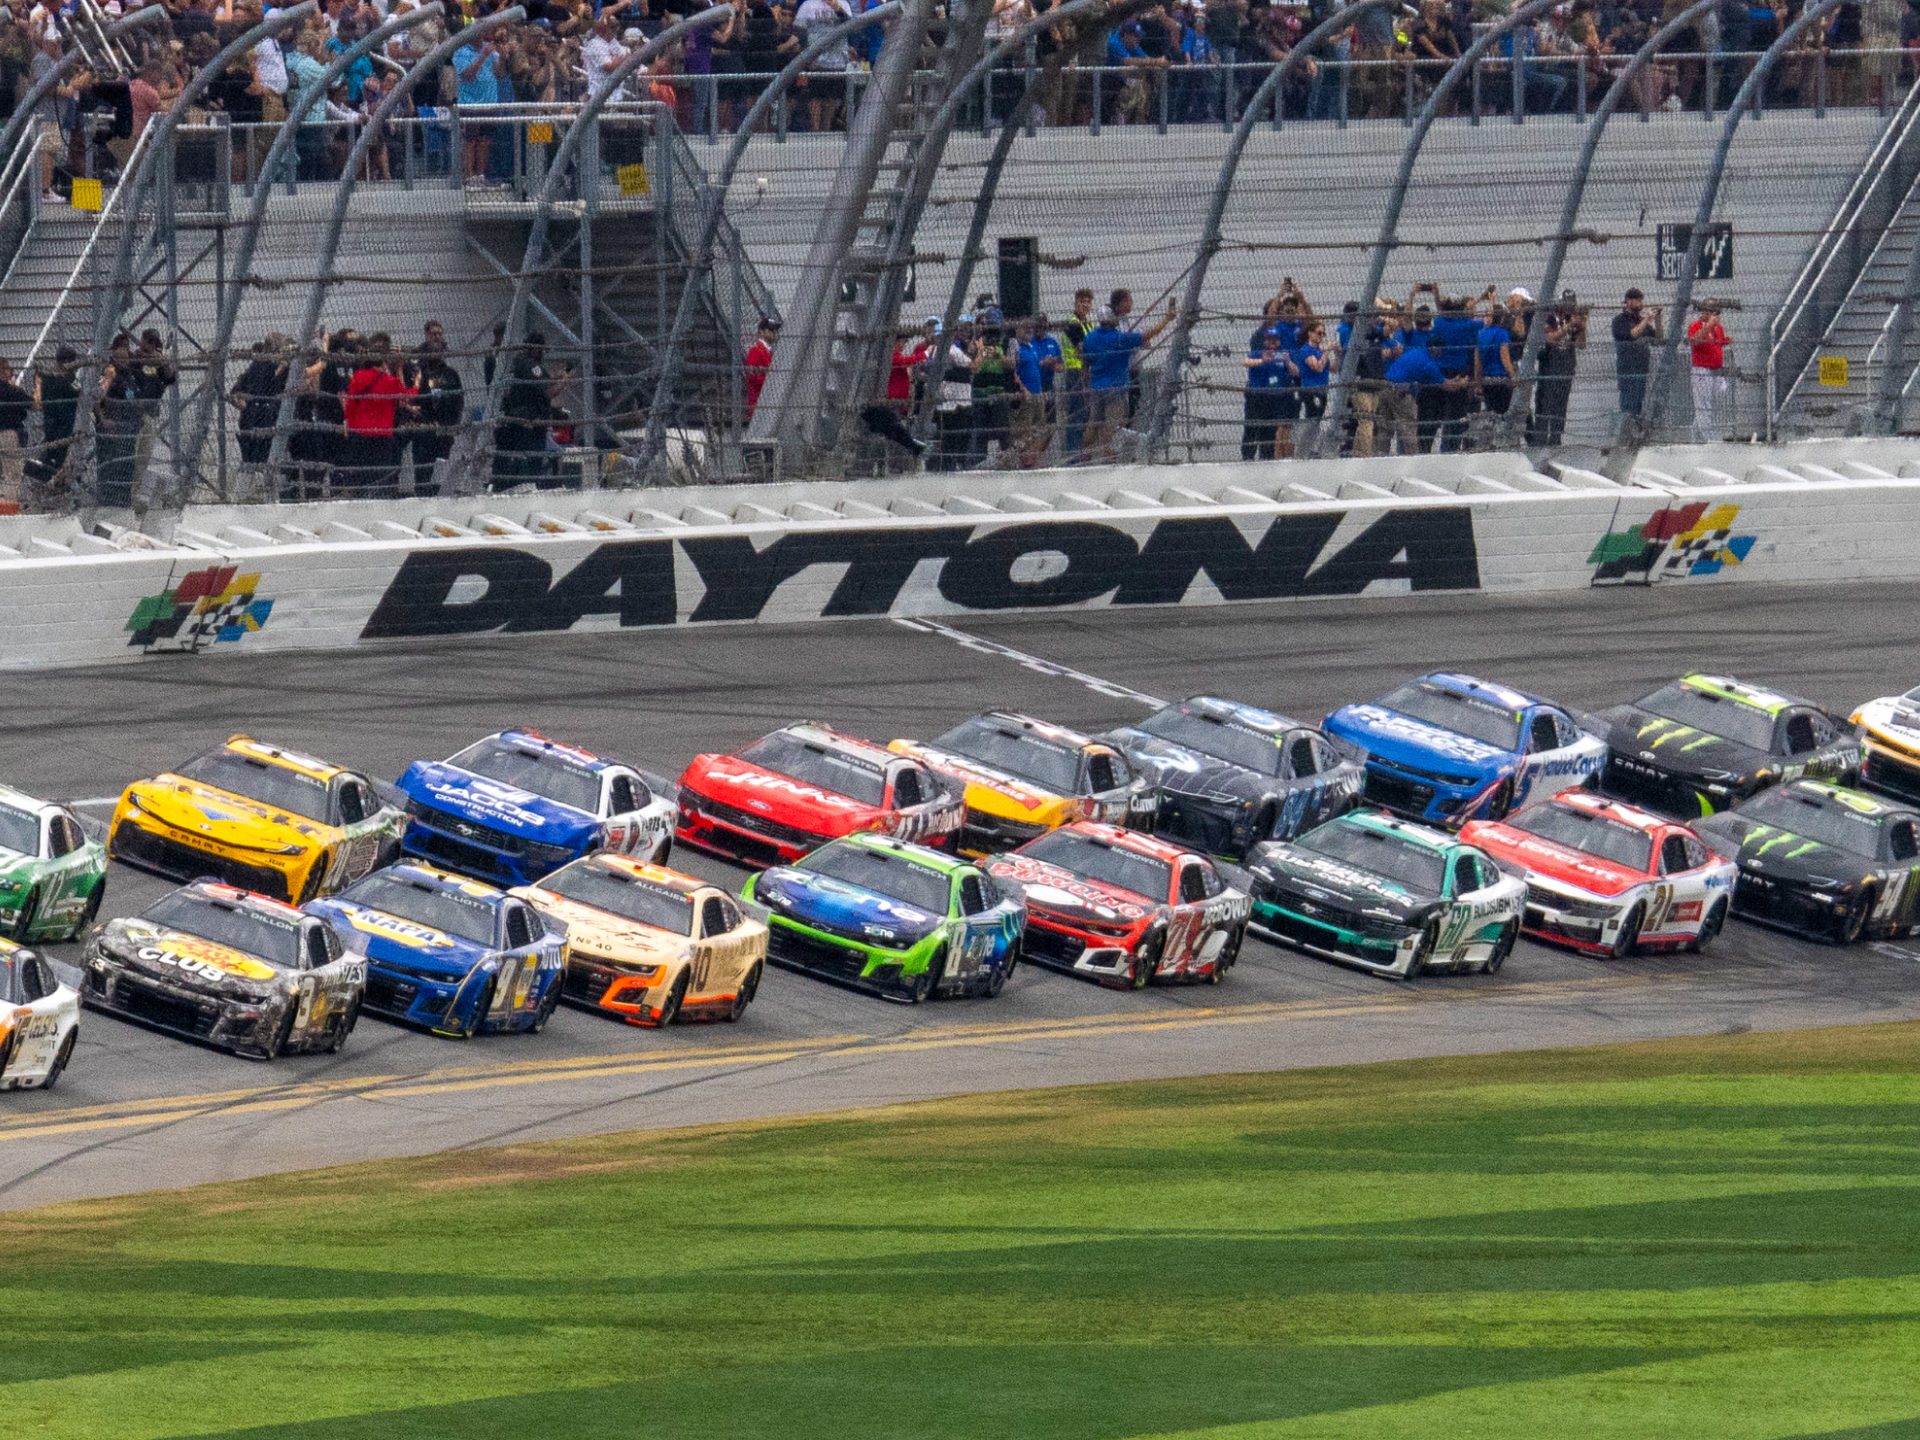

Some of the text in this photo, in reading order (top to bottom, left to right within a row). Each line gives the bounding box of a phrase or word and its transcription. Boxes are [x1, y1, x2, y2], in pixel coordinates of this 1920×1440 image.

[1662, 225, 1676, 251] ALL
[361, 507, 1480, 638] DAYTONA
[1614, 758, 1668, 780] CAMRY
[295, 773, 324, 789] BELL
[425, 782, 546, 827] JACOB
[434, 793, 524, 828] CONSTRUCTION
[170, 830, 225, 854] CAMRY
[907, 862, 947, 881] BUSCH
[441, 891, 486, 911] ELLIOTT
[251, 911, 294, 932] DILLON
[361, 911, 438, 943] NAPA
[863, 924, 895, 939] zone
[595, 942, 612, 952] 40
[137, 946, 227, 983] CLUB
